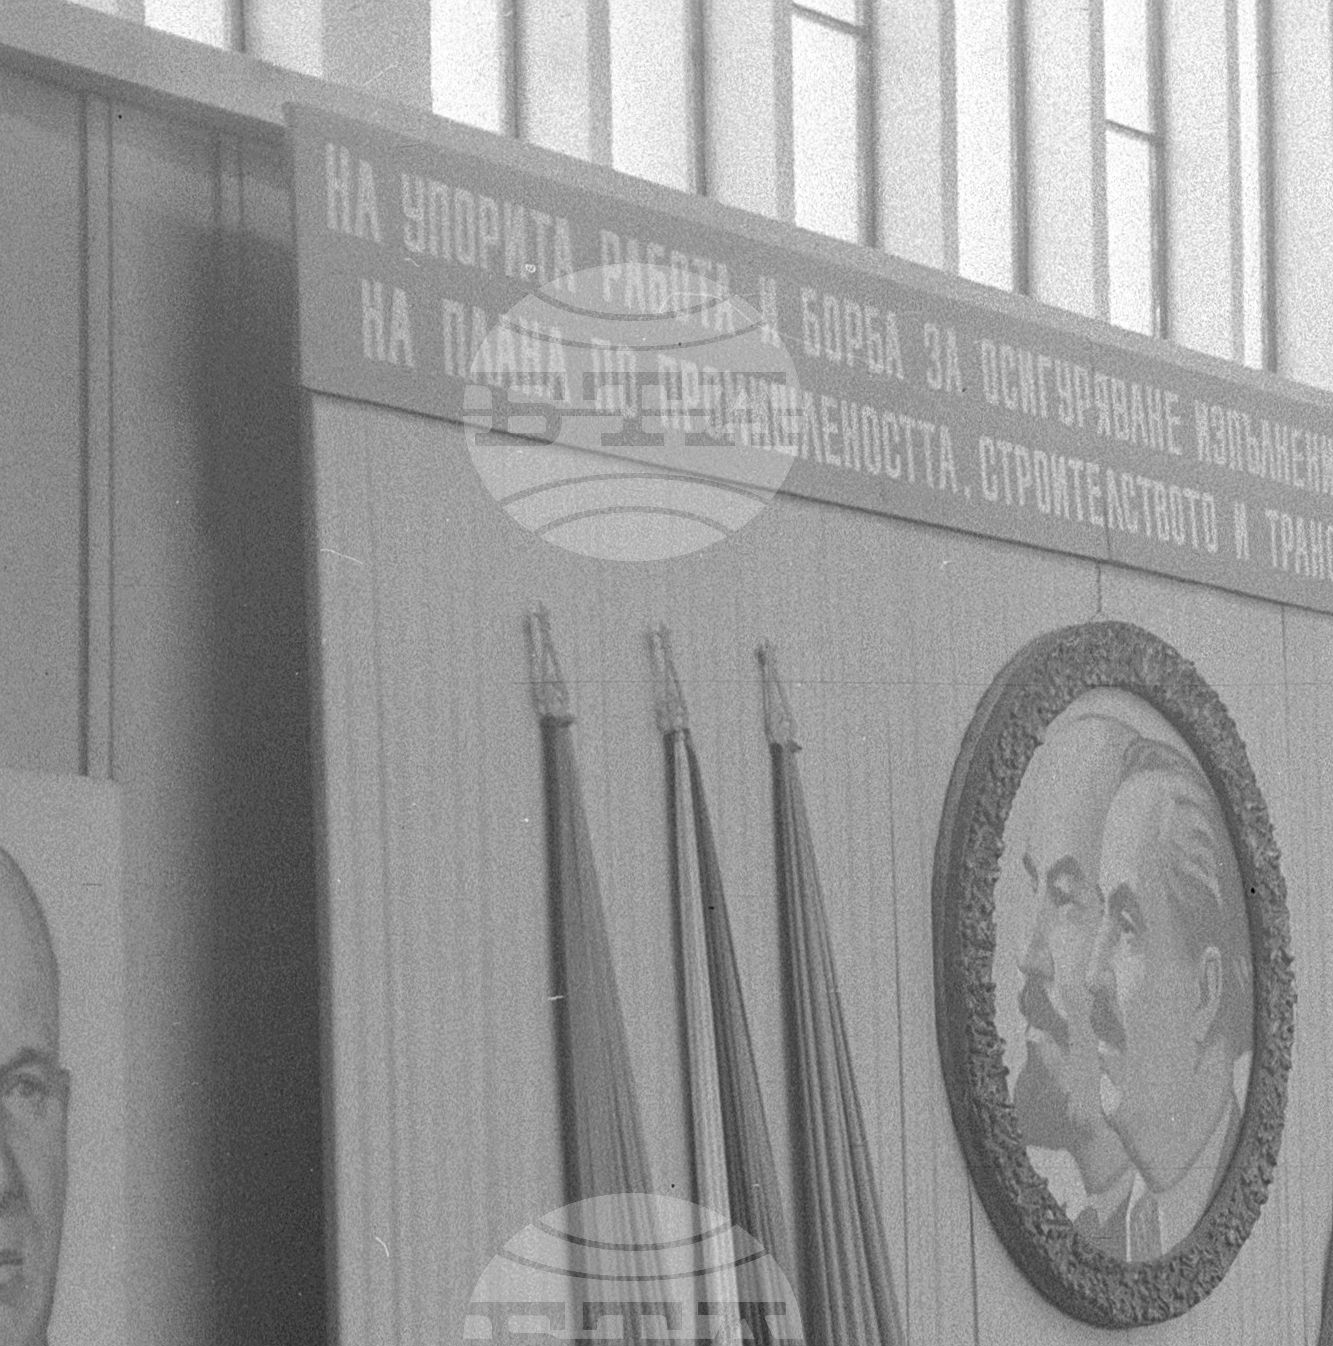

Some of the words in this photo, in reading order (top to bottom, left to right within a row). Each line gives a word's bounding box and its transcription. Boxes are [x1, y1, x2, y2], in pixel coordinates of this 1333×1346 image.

[324, 142, 383, 244] НА
[401, 172, 577, 295] УПОРИТА
[599, 228, 735, 333] РАБОТА
[759, 274, 781, 349] И
[800, 286, 905, 381] БОРБА
[923, 321, 964, 396] ЗА
[980, 337, 1183, 455] ОСИГУРЯВАНЕ
[359, 277, 415, 369] НА
[442, 298, 570, 405] ПЛАНА
[591, 338, 637, 416] ПО
[978, 434, 1219, 555] СТРОИТЕЛСТВОТО
[1233, 499, 1251, 561] И
